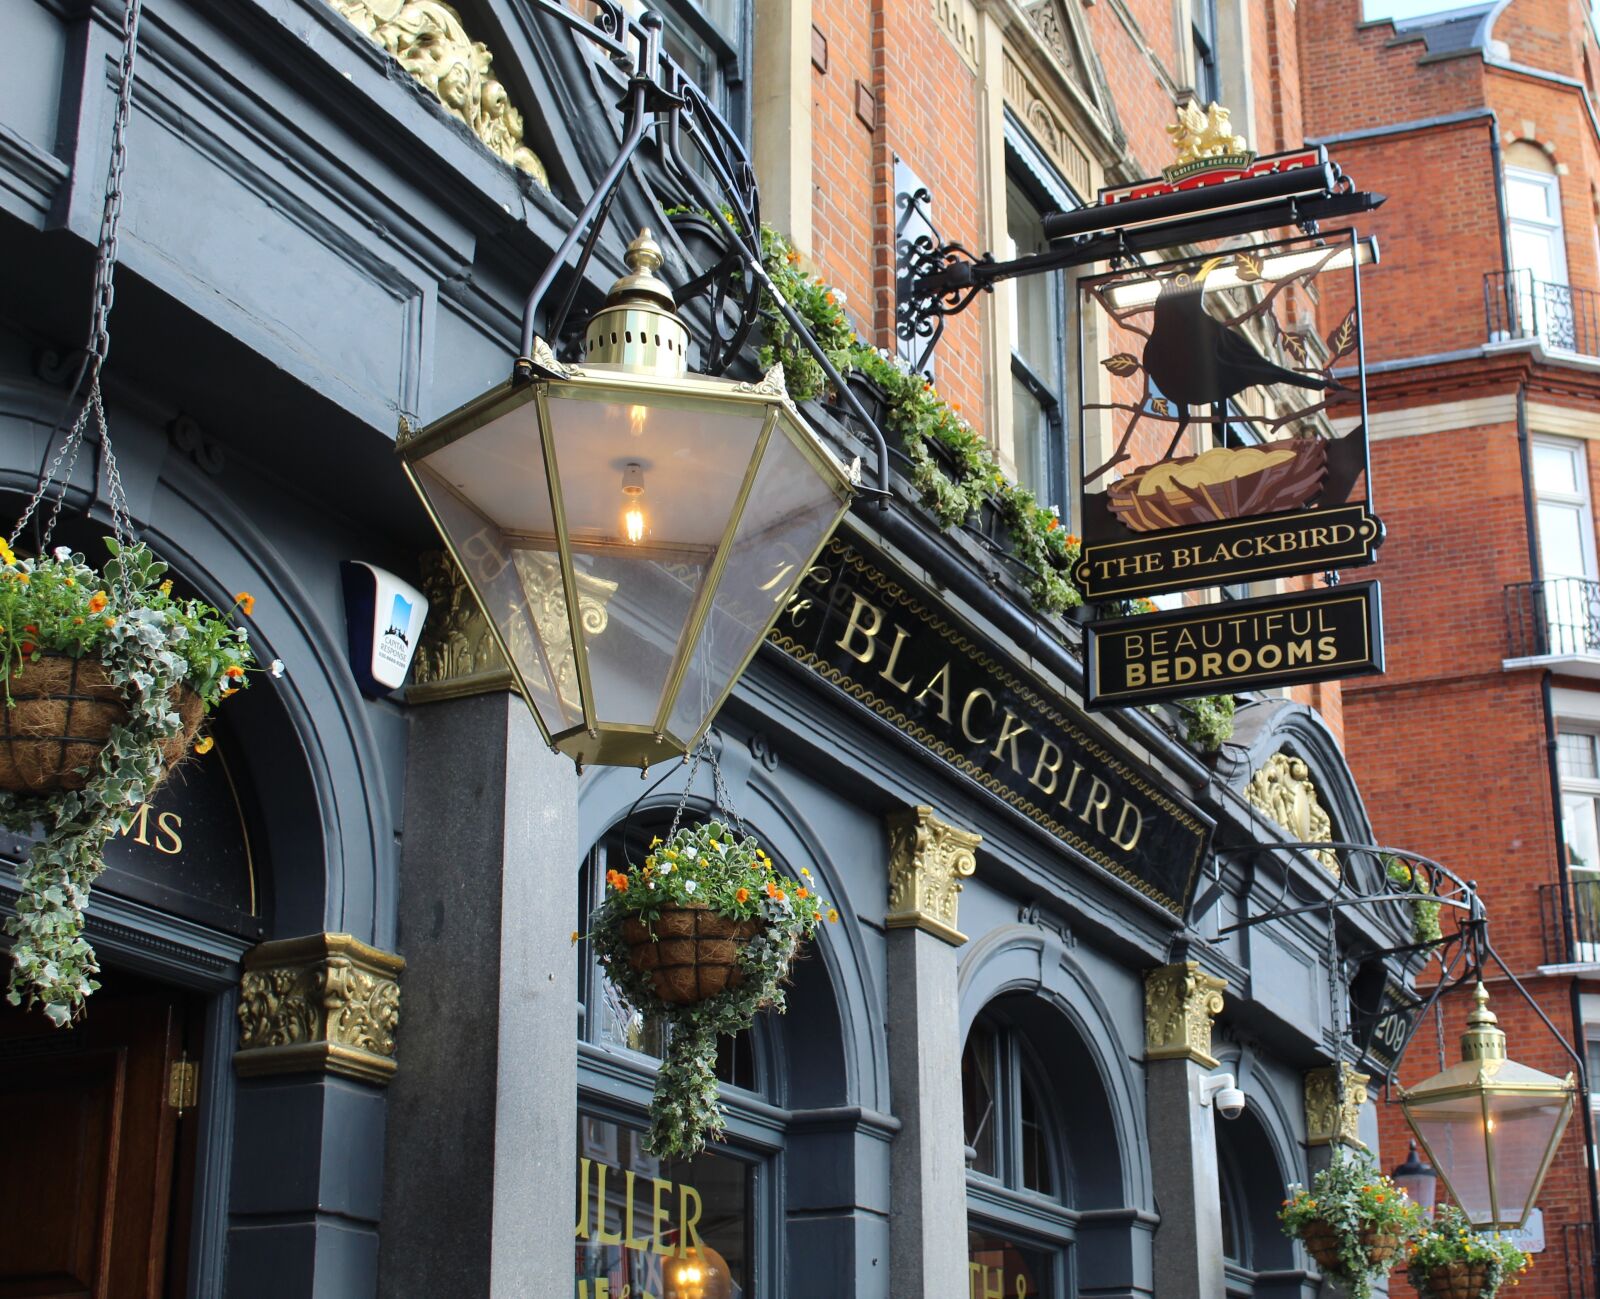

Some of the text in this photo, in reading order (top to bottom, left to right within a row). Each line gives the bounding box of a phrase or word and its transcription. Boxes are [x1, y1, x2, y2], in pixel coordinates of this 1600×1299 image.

[1095, 524, 1355, 580] THE BLACKBIRD
[380, 643, 407, 661] RESPONSE
[1125, 608, 1336, 660] BEAUTIFUL
[1126, 636, 1337, 688] BEDROOMS
[835, 591, 1143, 852] BLACKBIRD
[1374, 1005, 1406, 1052] 209
